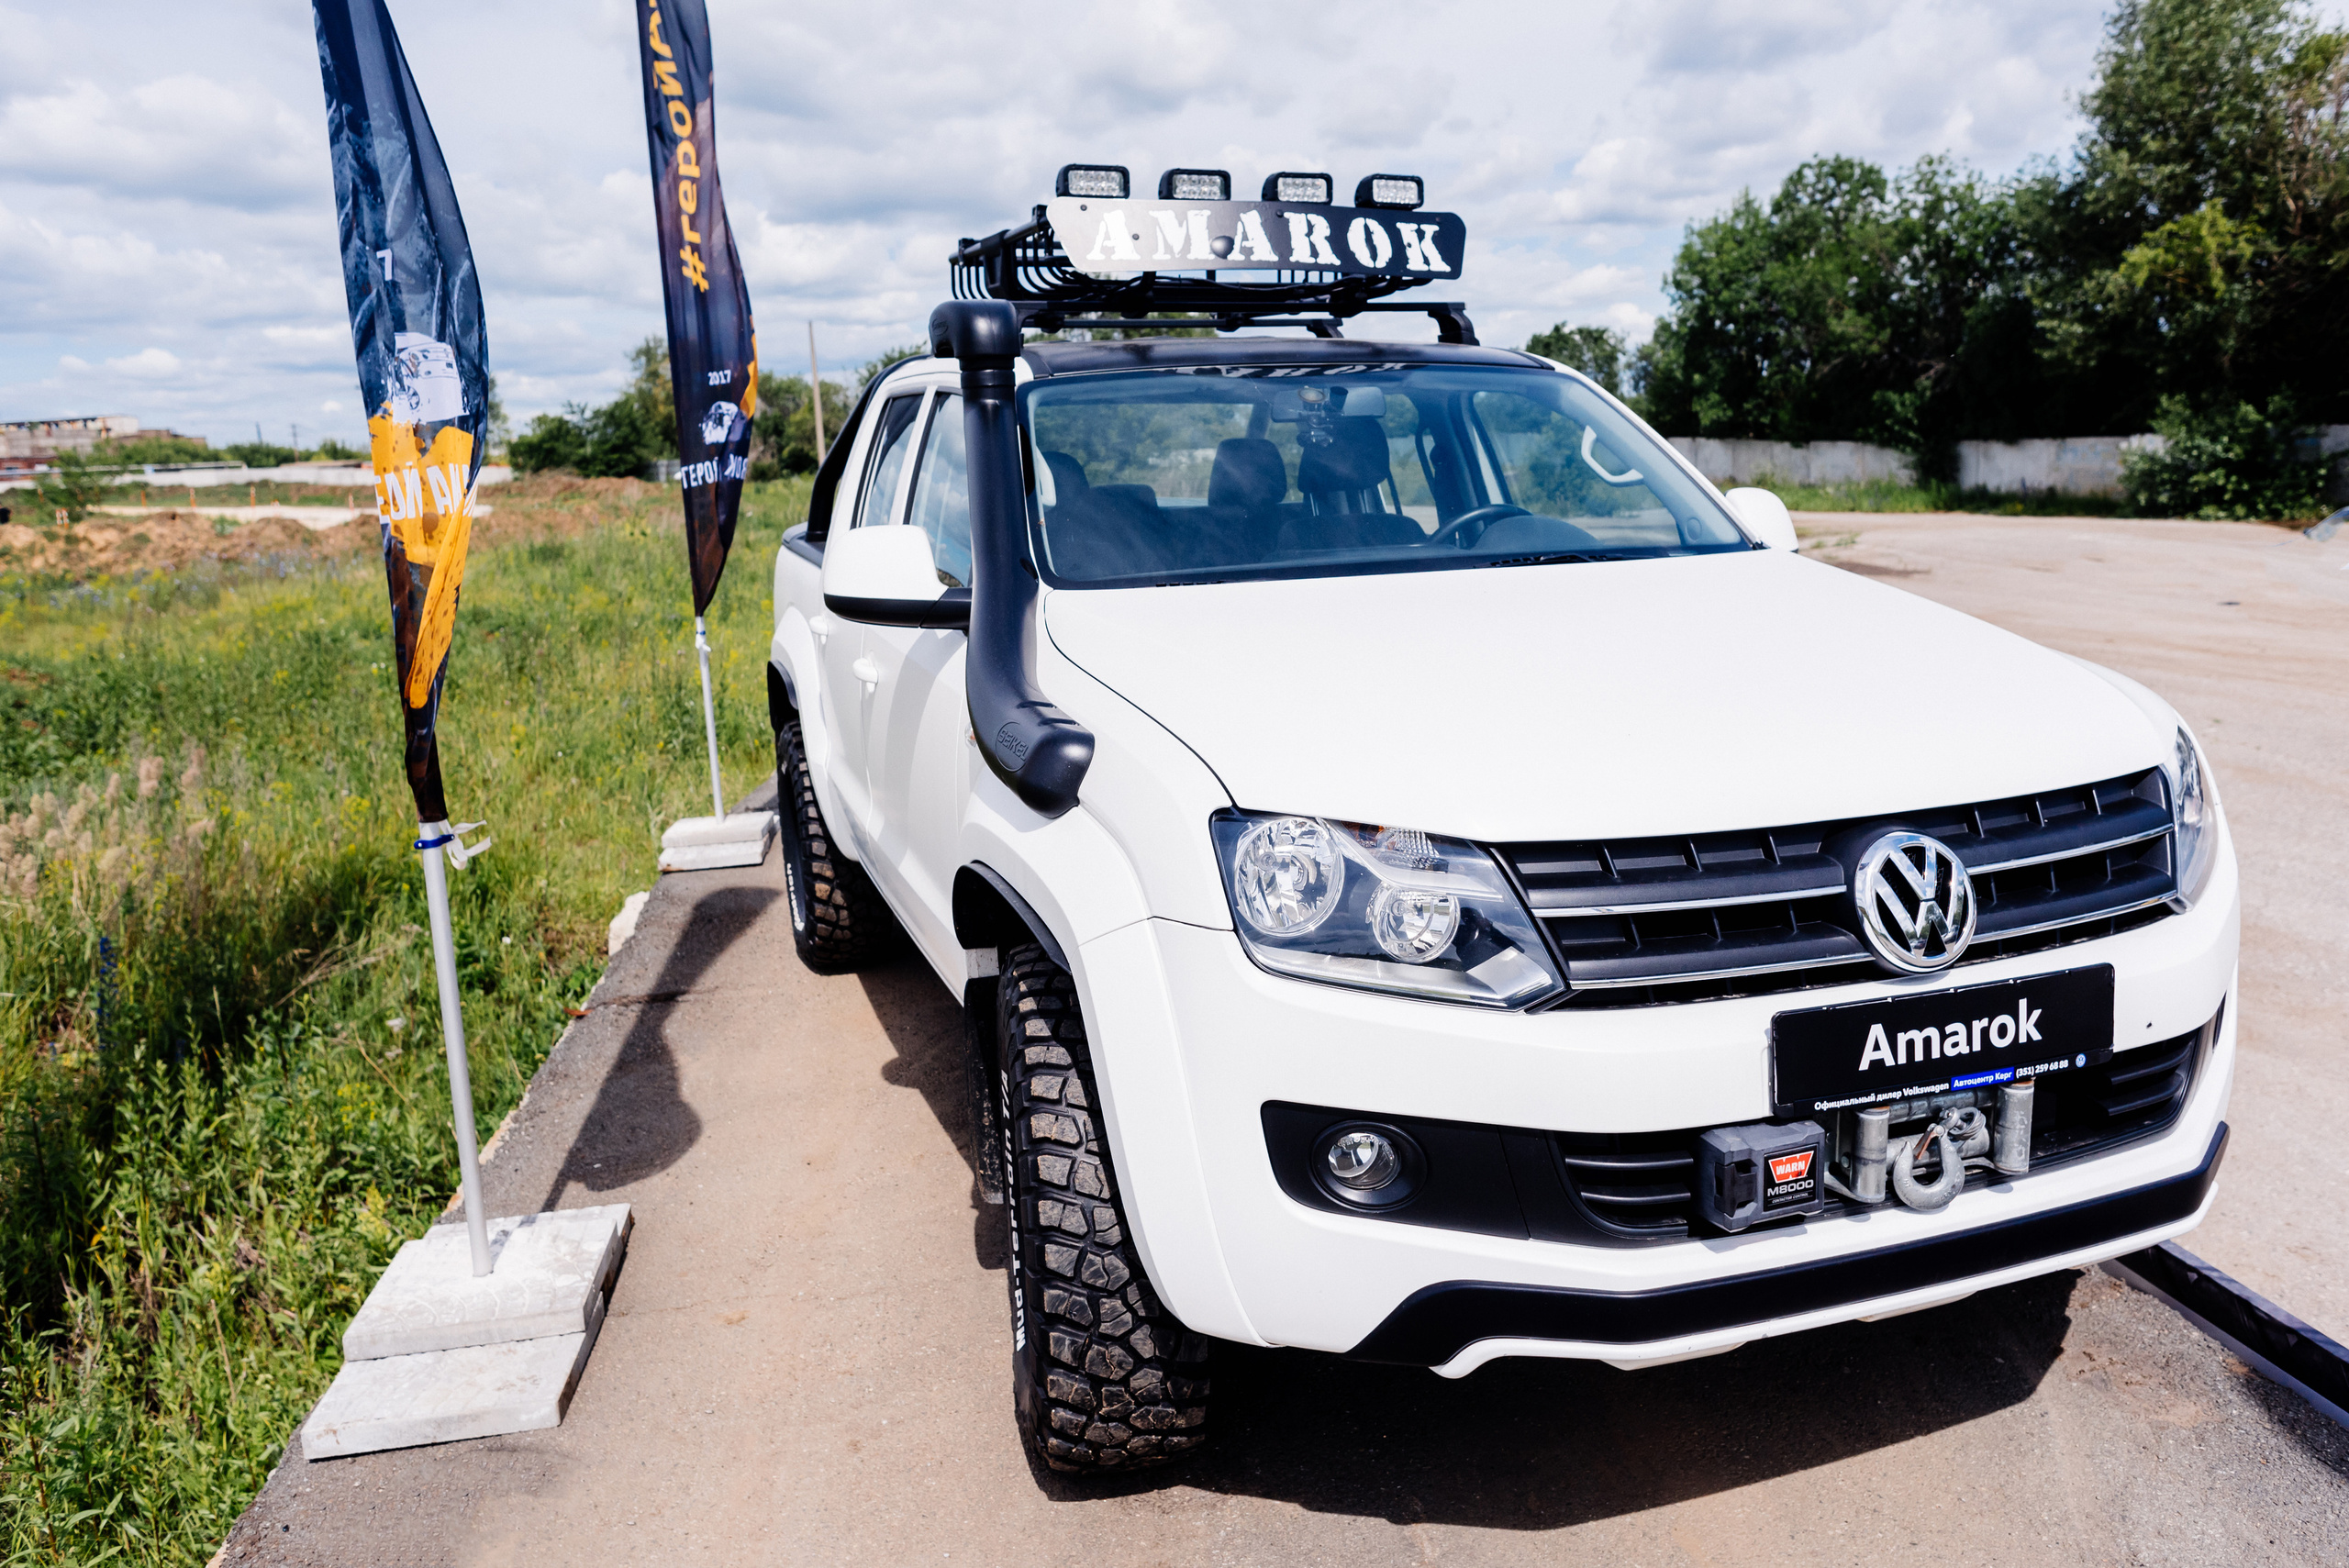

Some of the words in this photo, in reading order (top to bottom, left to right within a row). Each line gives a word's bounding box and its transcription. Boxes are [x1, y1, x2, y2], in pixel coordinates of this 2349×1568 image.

[1086, 209, 1452, 272] AMAROK
[707, 369, 731, 385] 2017
[997, 730, 1029, 762] SEIKEL
[1858, 997, 2043, 1071] Amarok
[1001, 1070, 1010, 1119] T/A
[1814, 1093, 1876, 1110] Официальный
[1876, 1089, 1902, 1102] дилер
[1903, 1082, 1950, 1096] Volkswagen
[1953, 1074, 1994, 1088] Автоцентр
[1995, 1071, 2012, 1082] Керг
[2015, 1066, 2034, 1079] (351)
[2035, 1062, 2049, 1073] 259
[1767, 1179, 1814, 1196] M8000
[1776, 1160, 1806, 1175] WARN
[1005, 1129, 1026, 1351] Mud-Terrain
